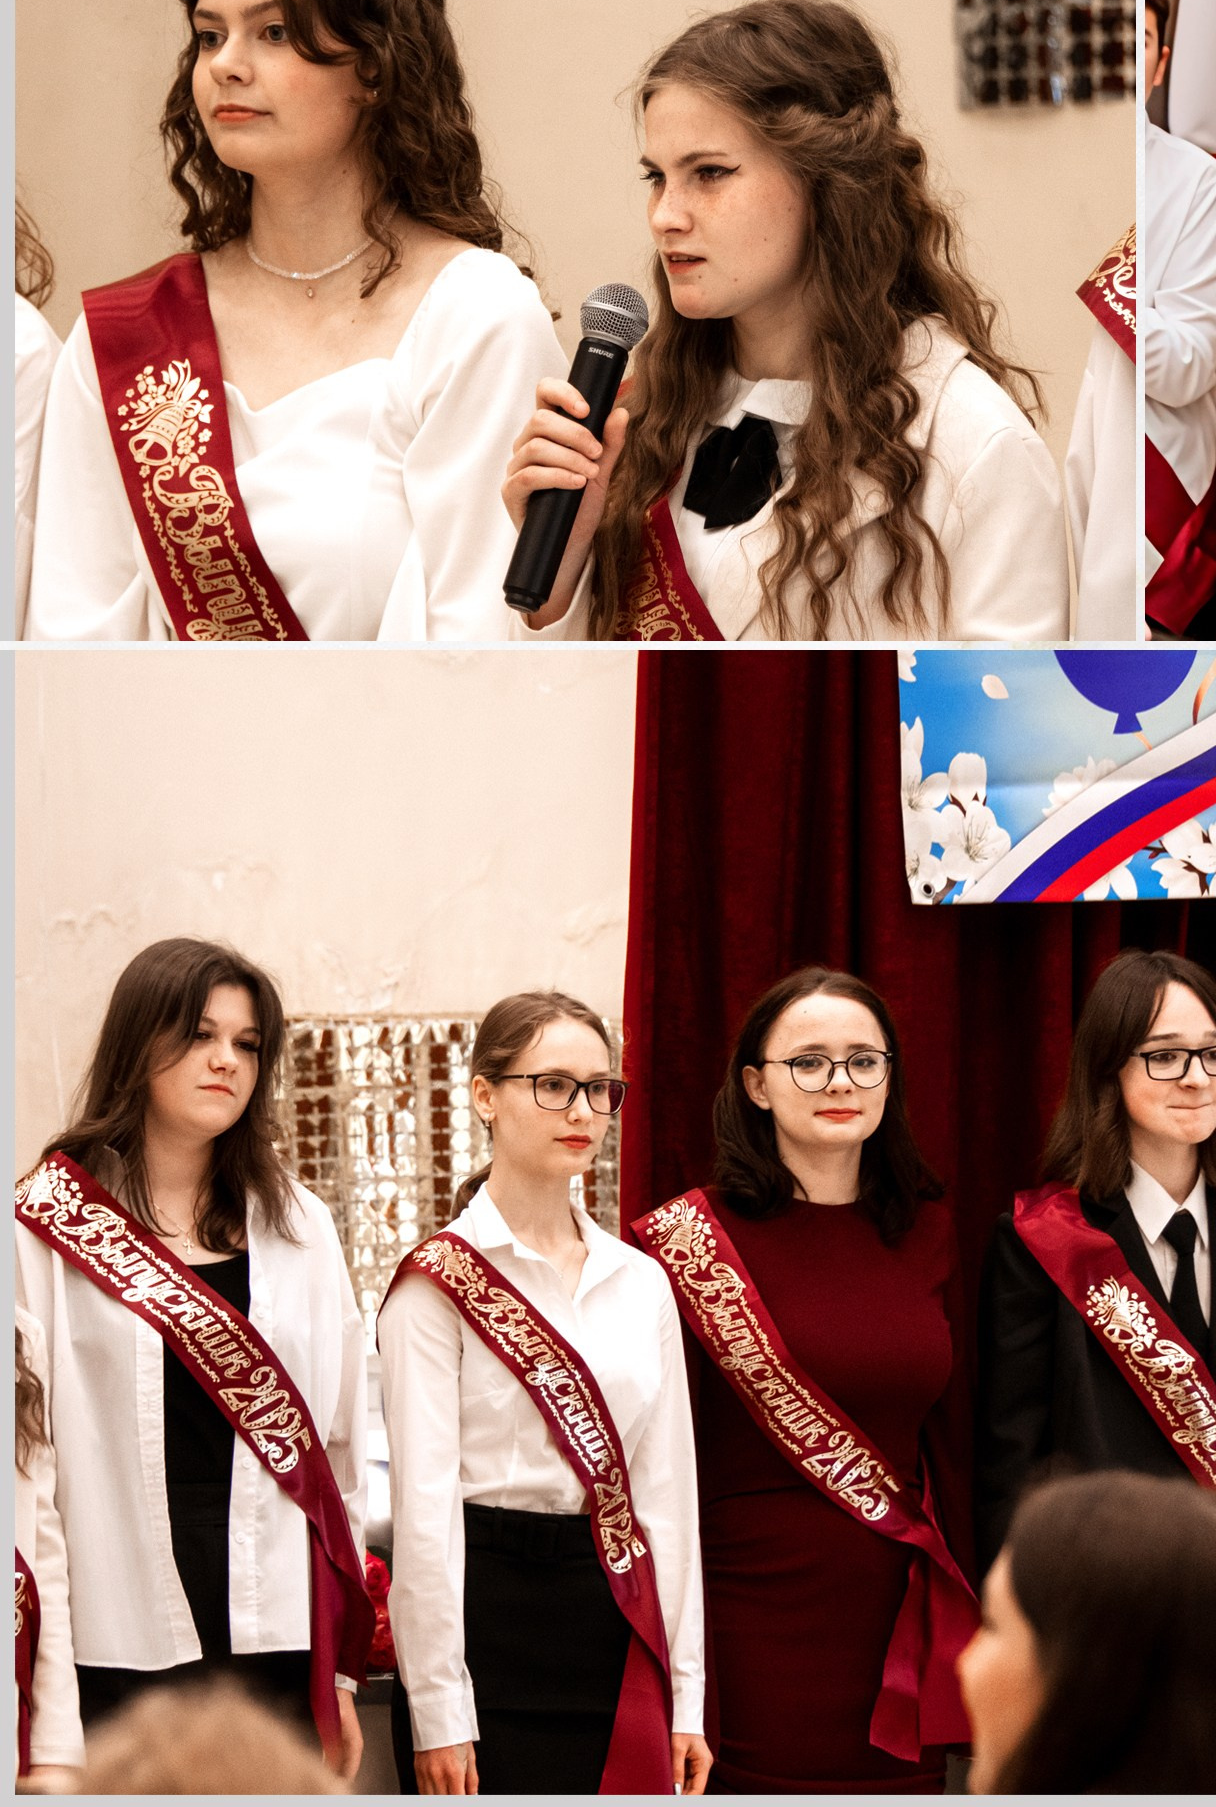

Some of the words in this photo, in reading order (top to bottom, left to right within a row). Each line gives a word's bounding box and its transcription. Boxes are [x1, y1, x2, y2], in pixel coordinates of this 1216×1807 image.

[588, 345, 615, 360] SHURE
[153, 464, 264, 642] Выпу
[56, 1200, 261, 1380] Выпускник
[218, 1367, 312, 1474] 2025
[470, 1284, 612, 1474] Выпускник
[591, 1468, 646, 1575] 2025
[682, 1259, 830, 1455] Выпускник
[800, 1430, 900, 1523] 2025
